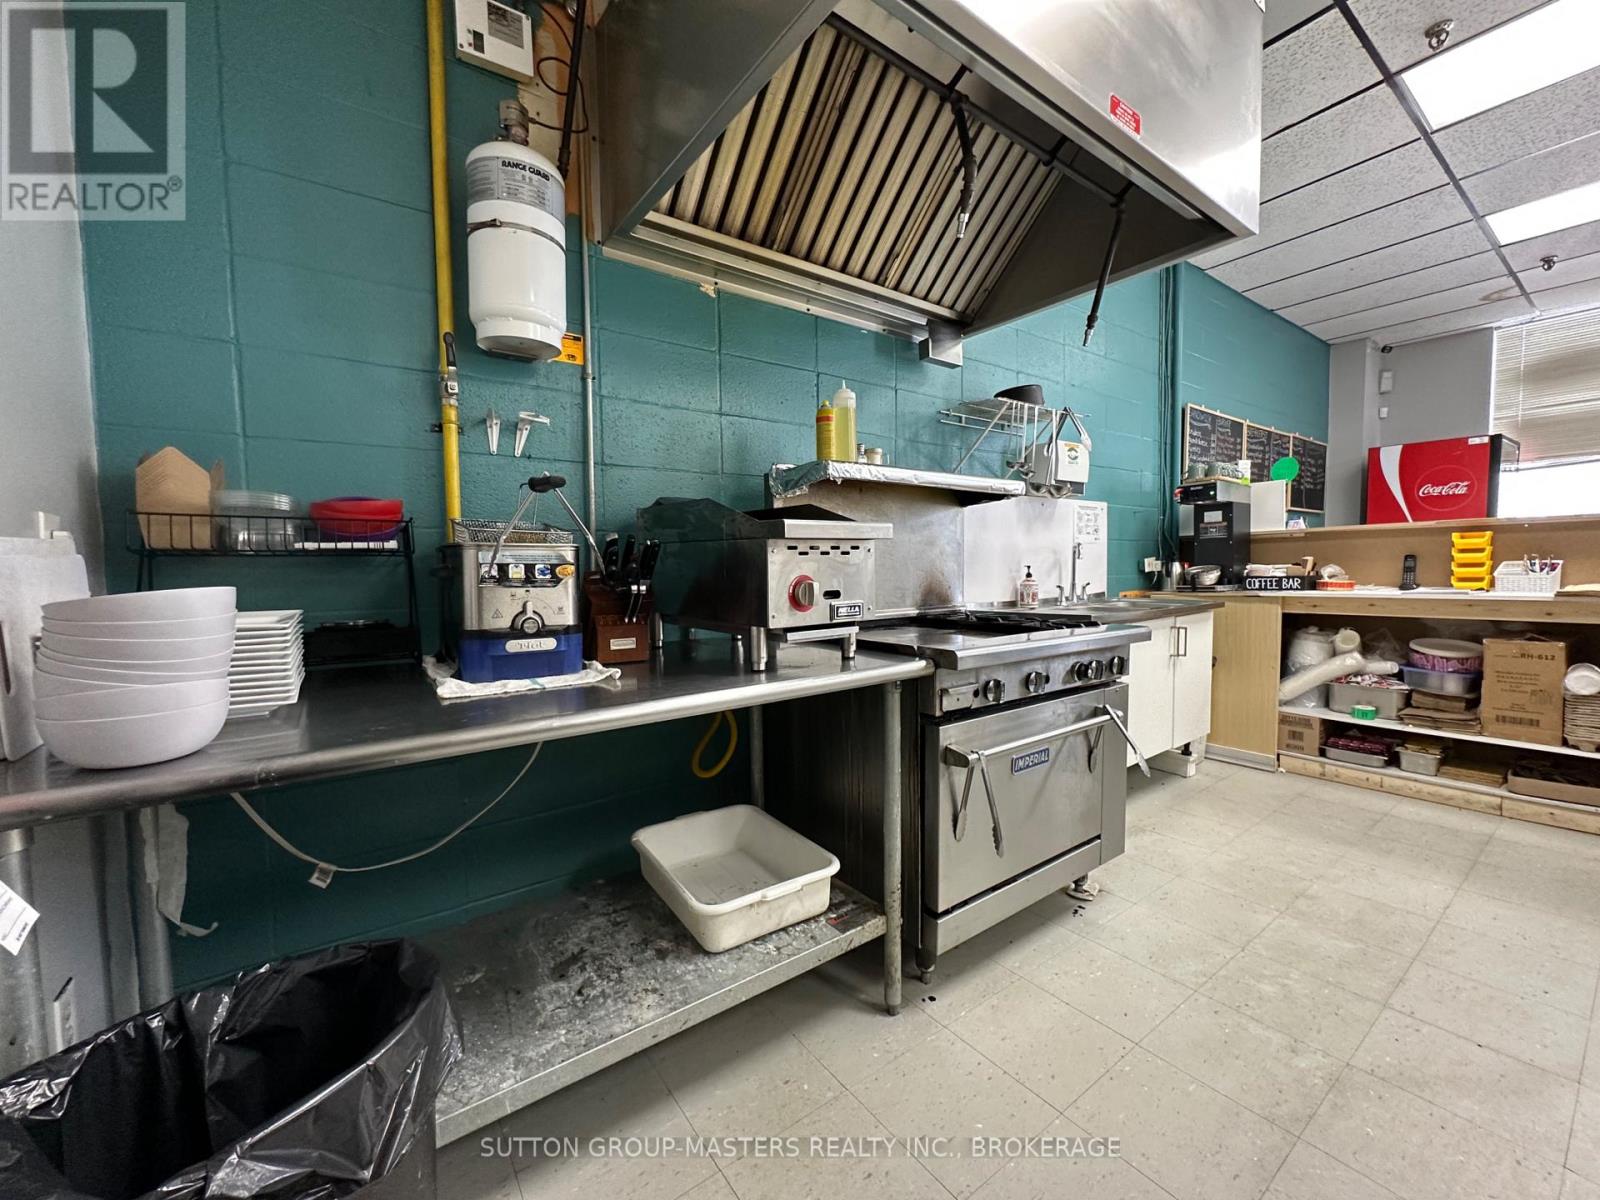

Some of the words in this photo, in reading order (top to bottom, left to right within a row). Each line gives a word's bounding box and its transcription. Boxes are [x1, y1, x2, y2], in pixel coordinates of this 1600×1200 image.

[501, 160, 527, 172] RANGE
[528, 166, 551, 182] GUARD
[1419, 481, 1471, 497] Coca-Cola
[1245, 578, 1279, 589] COFFEE
[1282, 577, 1301, 589] BAR
[1015, 749, 1049, 771] IMPERIAL
